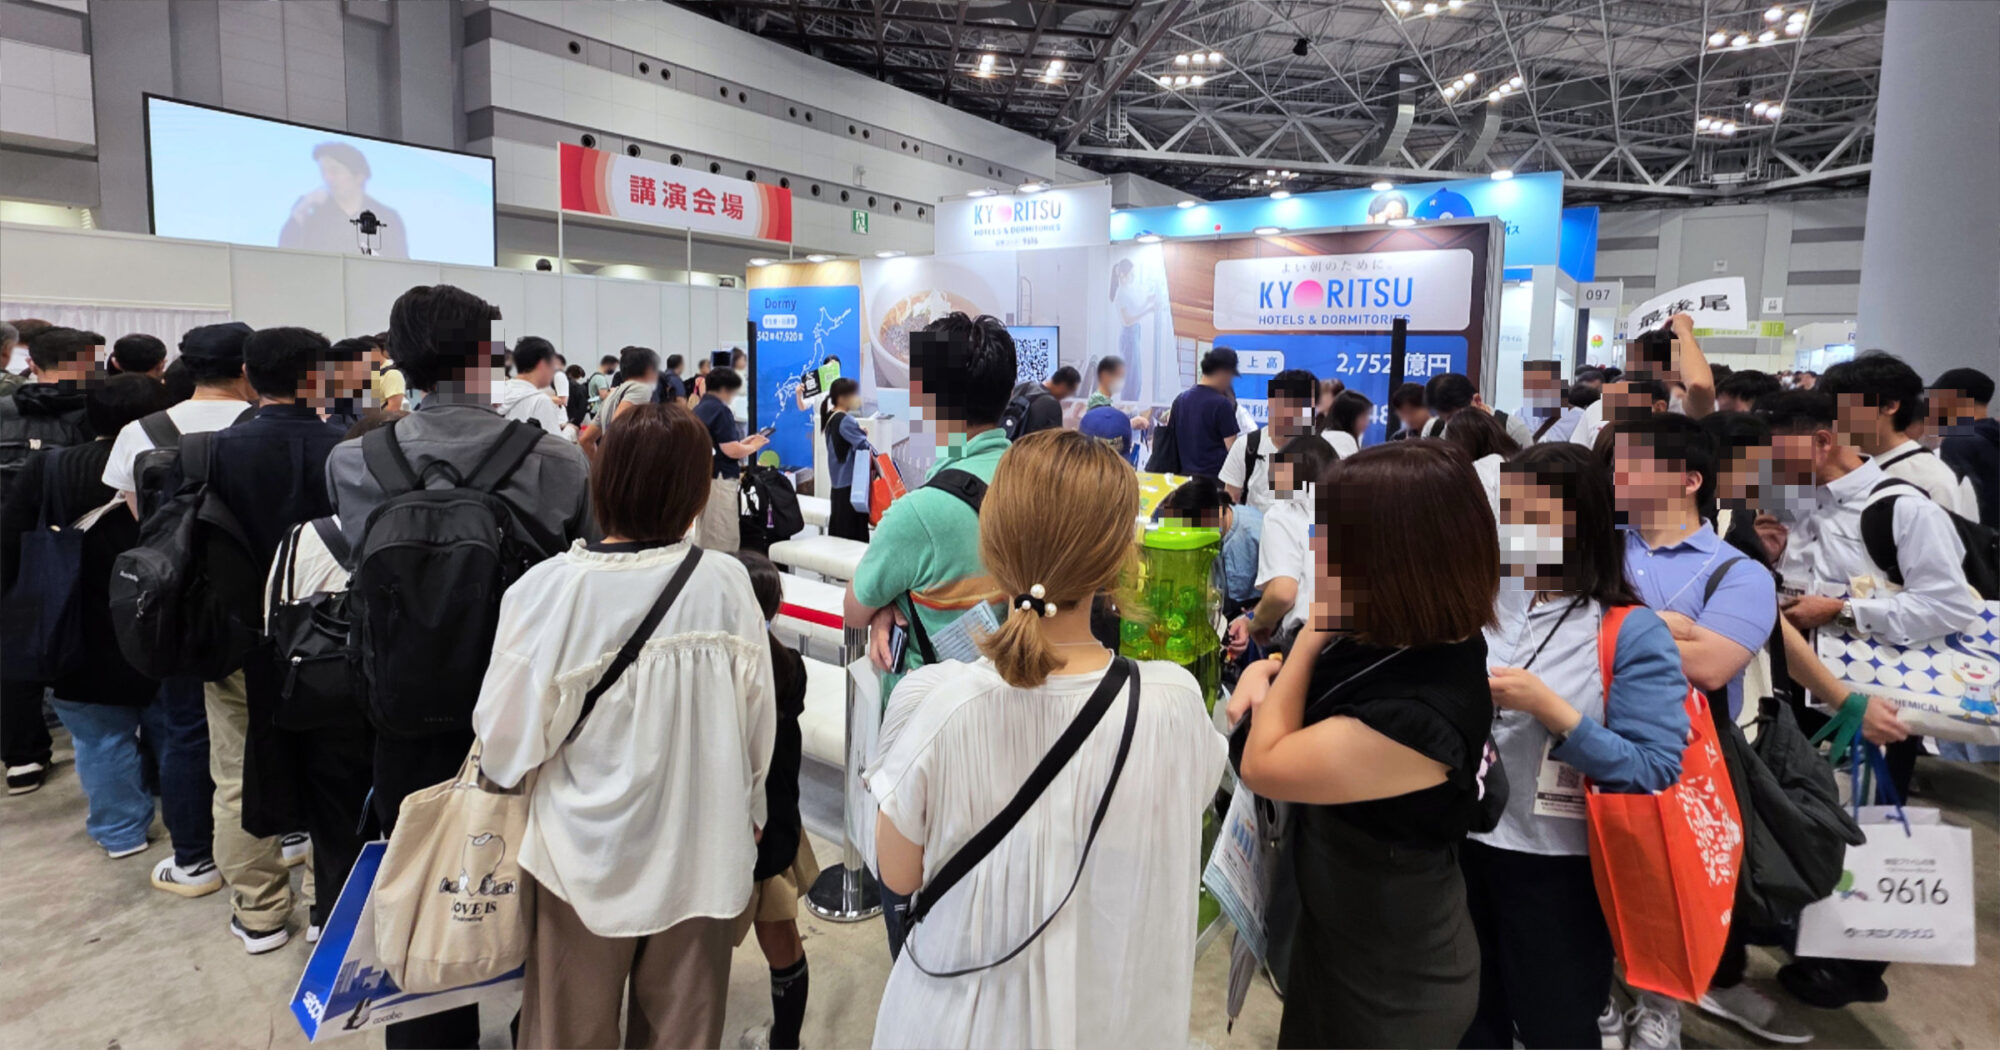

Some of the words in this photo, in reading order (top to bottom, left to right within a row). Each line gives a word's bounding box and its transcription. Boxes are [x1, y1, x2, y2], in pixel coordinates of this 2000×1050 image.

[630, 175, 743, 220] 講演会場
[974, 199, 1061, 224] KYORITSU
[974, 226, 1001, 236] HOTELS
[1010, 223, 1061, 234] DORMITORIES
[1022, 237, 1038, 246] 9616
[1281, 259, 1393, 274] よい朝のために。
[1259, 277, 1414, 309] KYORITSU
[1585, 288, 1611, 301] 097
[764, 297, 797, 312] Dormy
[1638, 294, 1731, 330] 最後尾
[1258, 314, 1305, 325] HOTELS
[1308, 314, 1317, 325] &
[1237, 355, 1278, 369] 上高
[1877, 877, 1949, 905] 9616
[485, 901, 497, 914] IS
